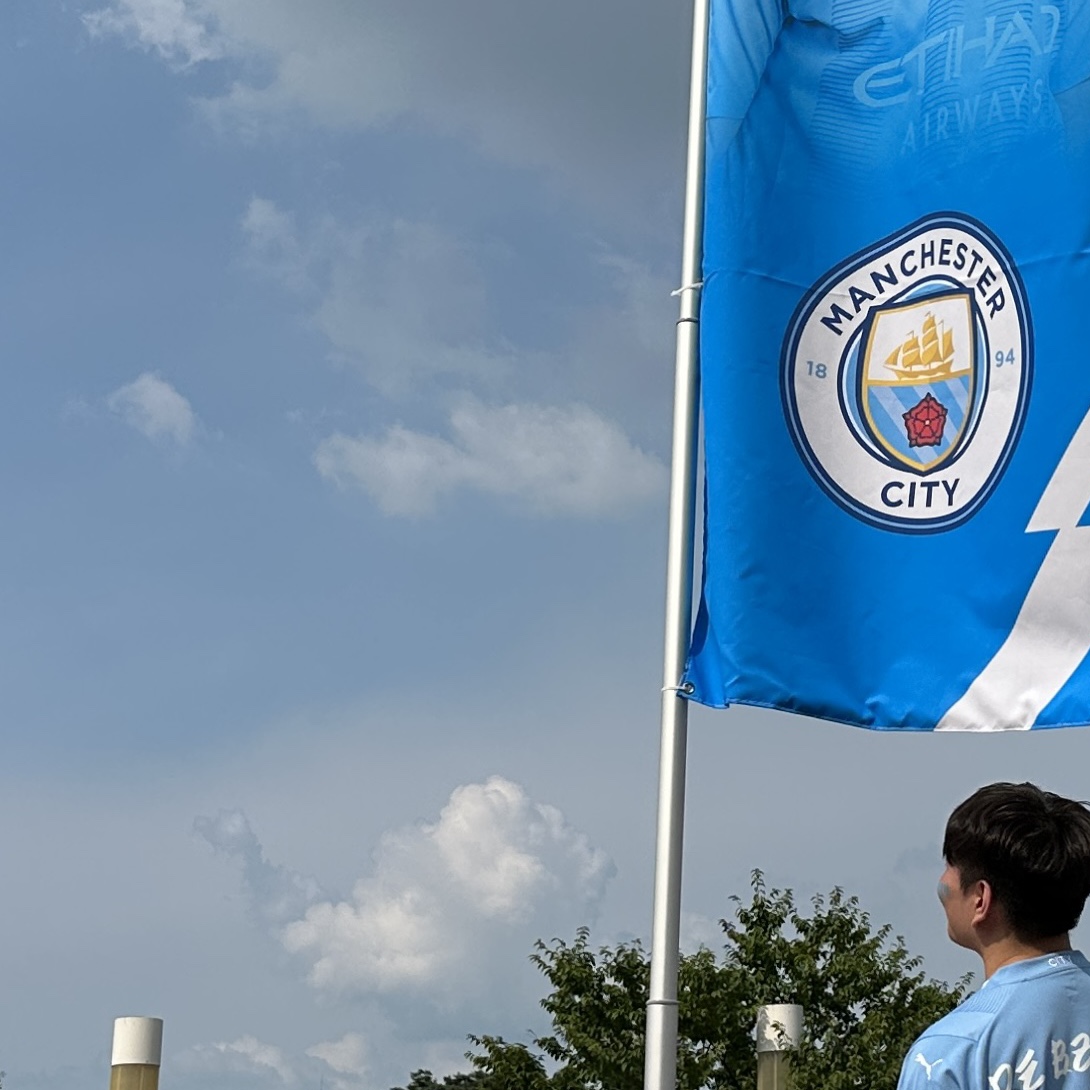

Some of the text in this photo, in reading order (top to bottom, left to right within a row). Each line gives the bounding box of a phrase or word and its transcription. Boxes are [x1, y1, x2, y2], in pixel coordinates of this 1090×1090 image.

[902, 78, 1045, 154] AIRWAYS
[820, 238, 1006, 336] MANCHESTER
[806, 360, 828, 379] 18
[995, 348, 1015, 368] 94
[880, 478, 961, 508] CITY
